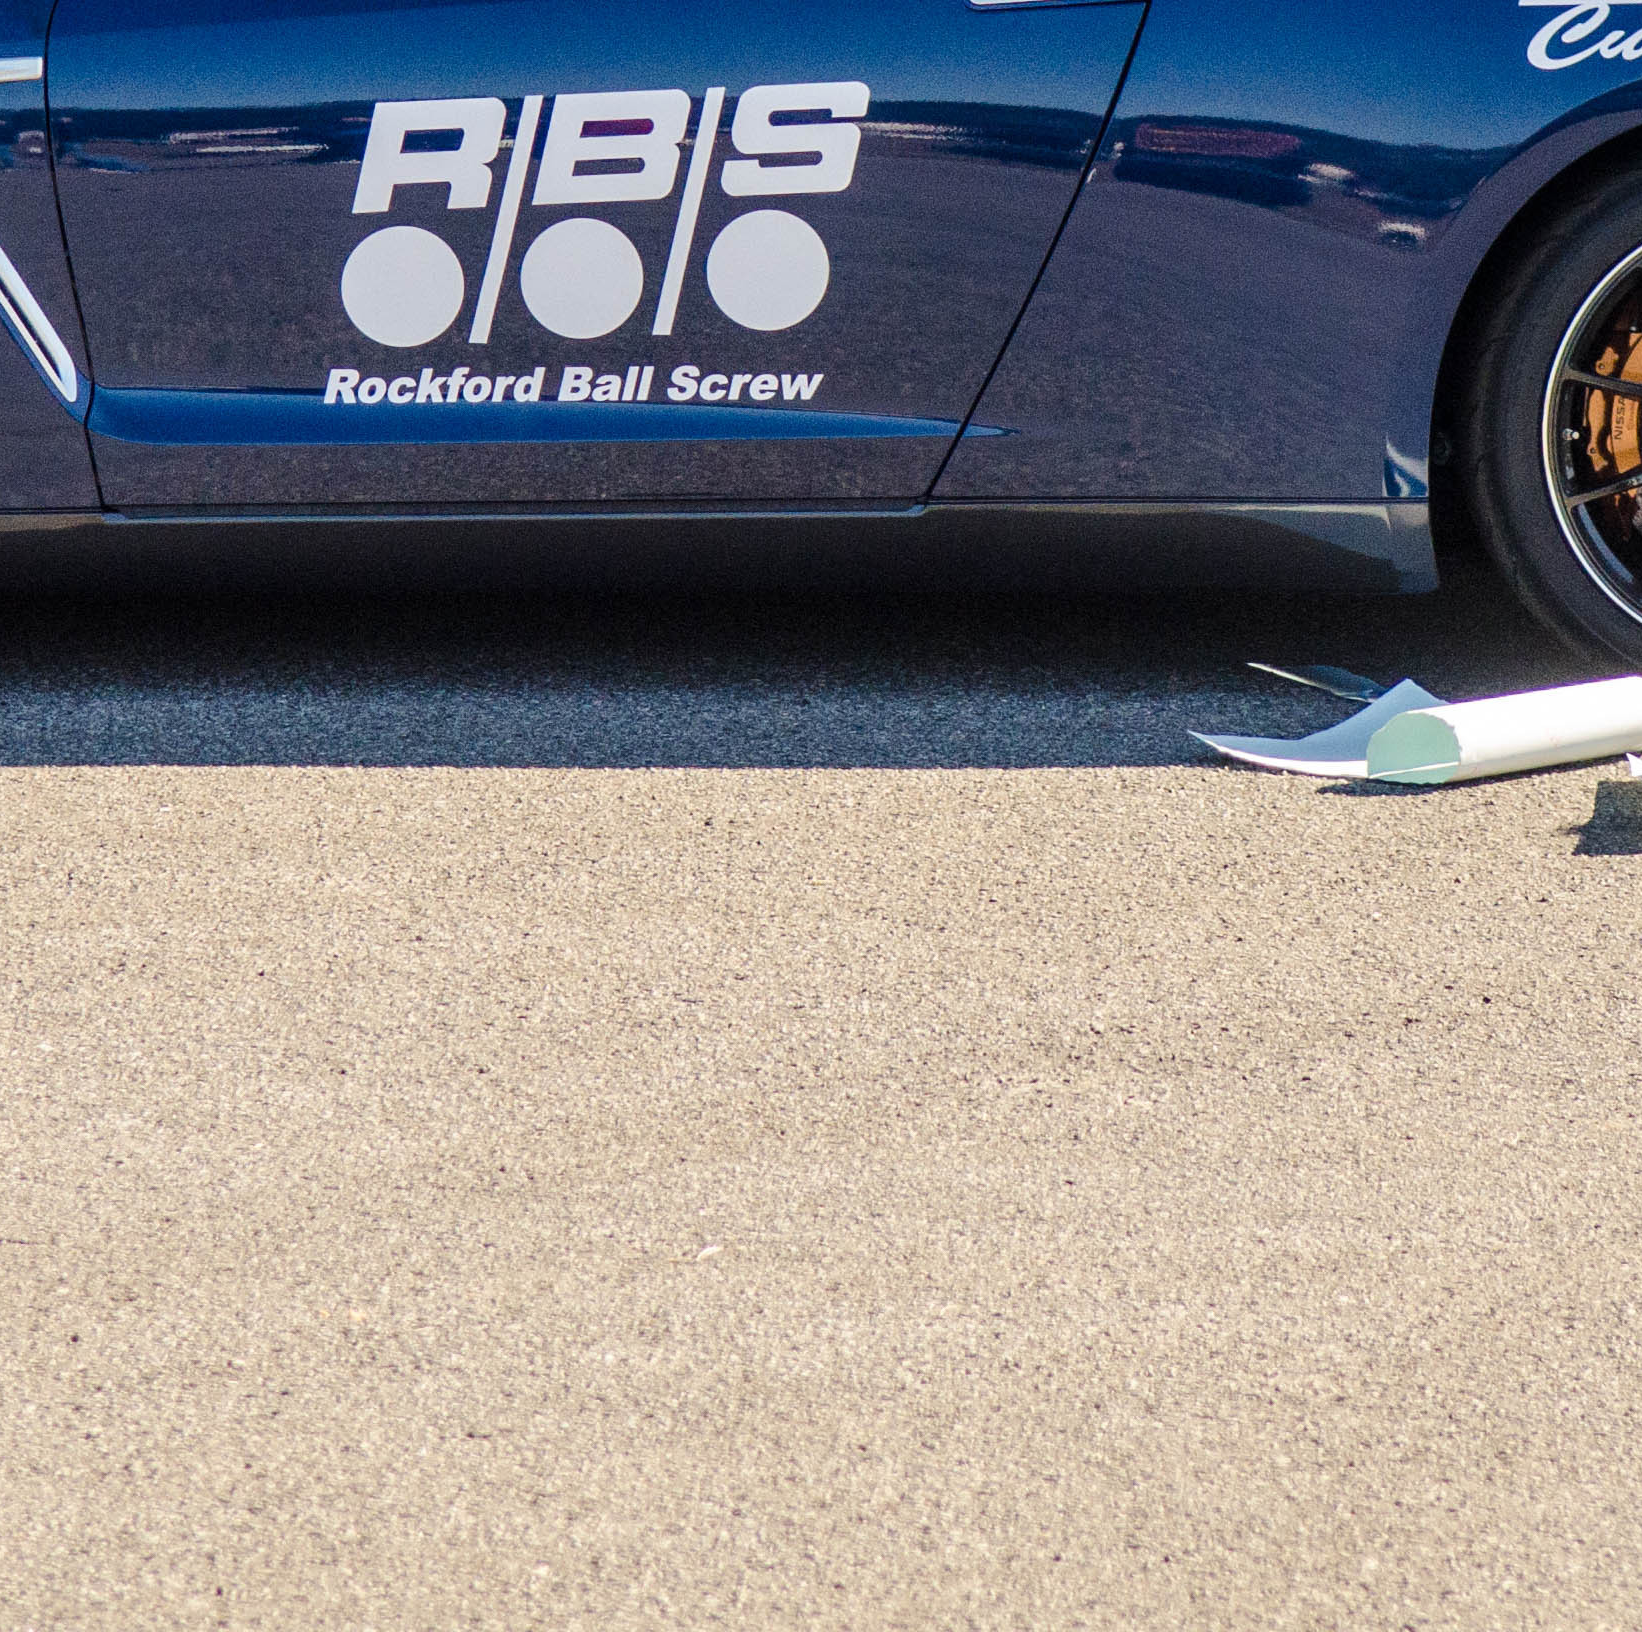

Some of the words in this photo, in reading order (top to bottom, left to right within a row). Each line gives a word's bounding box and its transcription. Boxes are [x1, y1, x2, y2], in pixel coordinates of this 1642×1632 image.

[324, 366, 546, 405] Rockford
[558, 365, 655, 402] Ball
[667, 365, 825, 402] Screw
